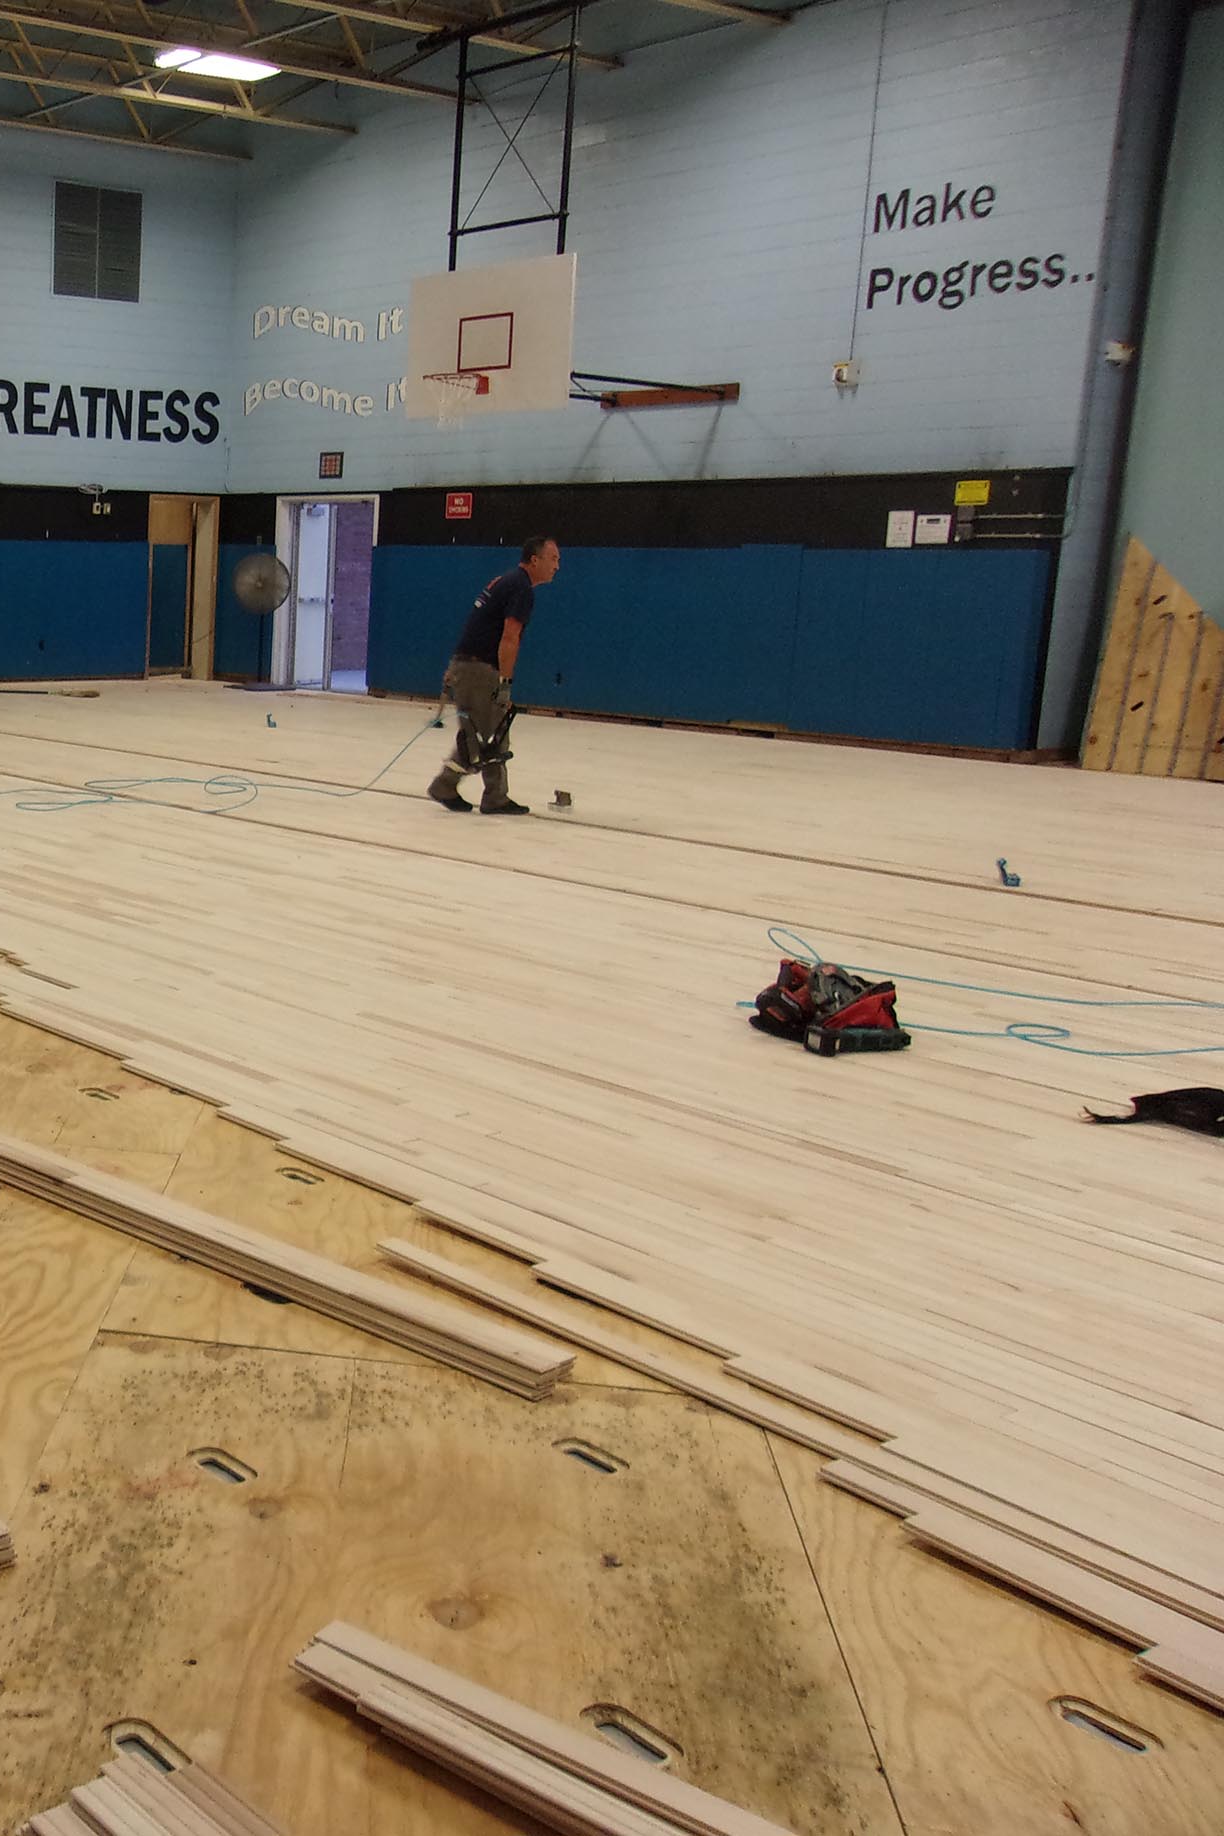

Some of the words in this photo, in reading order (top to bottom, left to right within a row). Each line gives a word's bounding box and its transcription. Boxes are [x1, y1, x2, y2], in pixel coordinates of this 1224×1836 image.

[873, 182, 996, 233] Make
[253, 304, 365, 342] Dream
[377, 307, 404, 341] It
[243, 377, 374, 417] Become
[454, 497, 464, 506] NO
